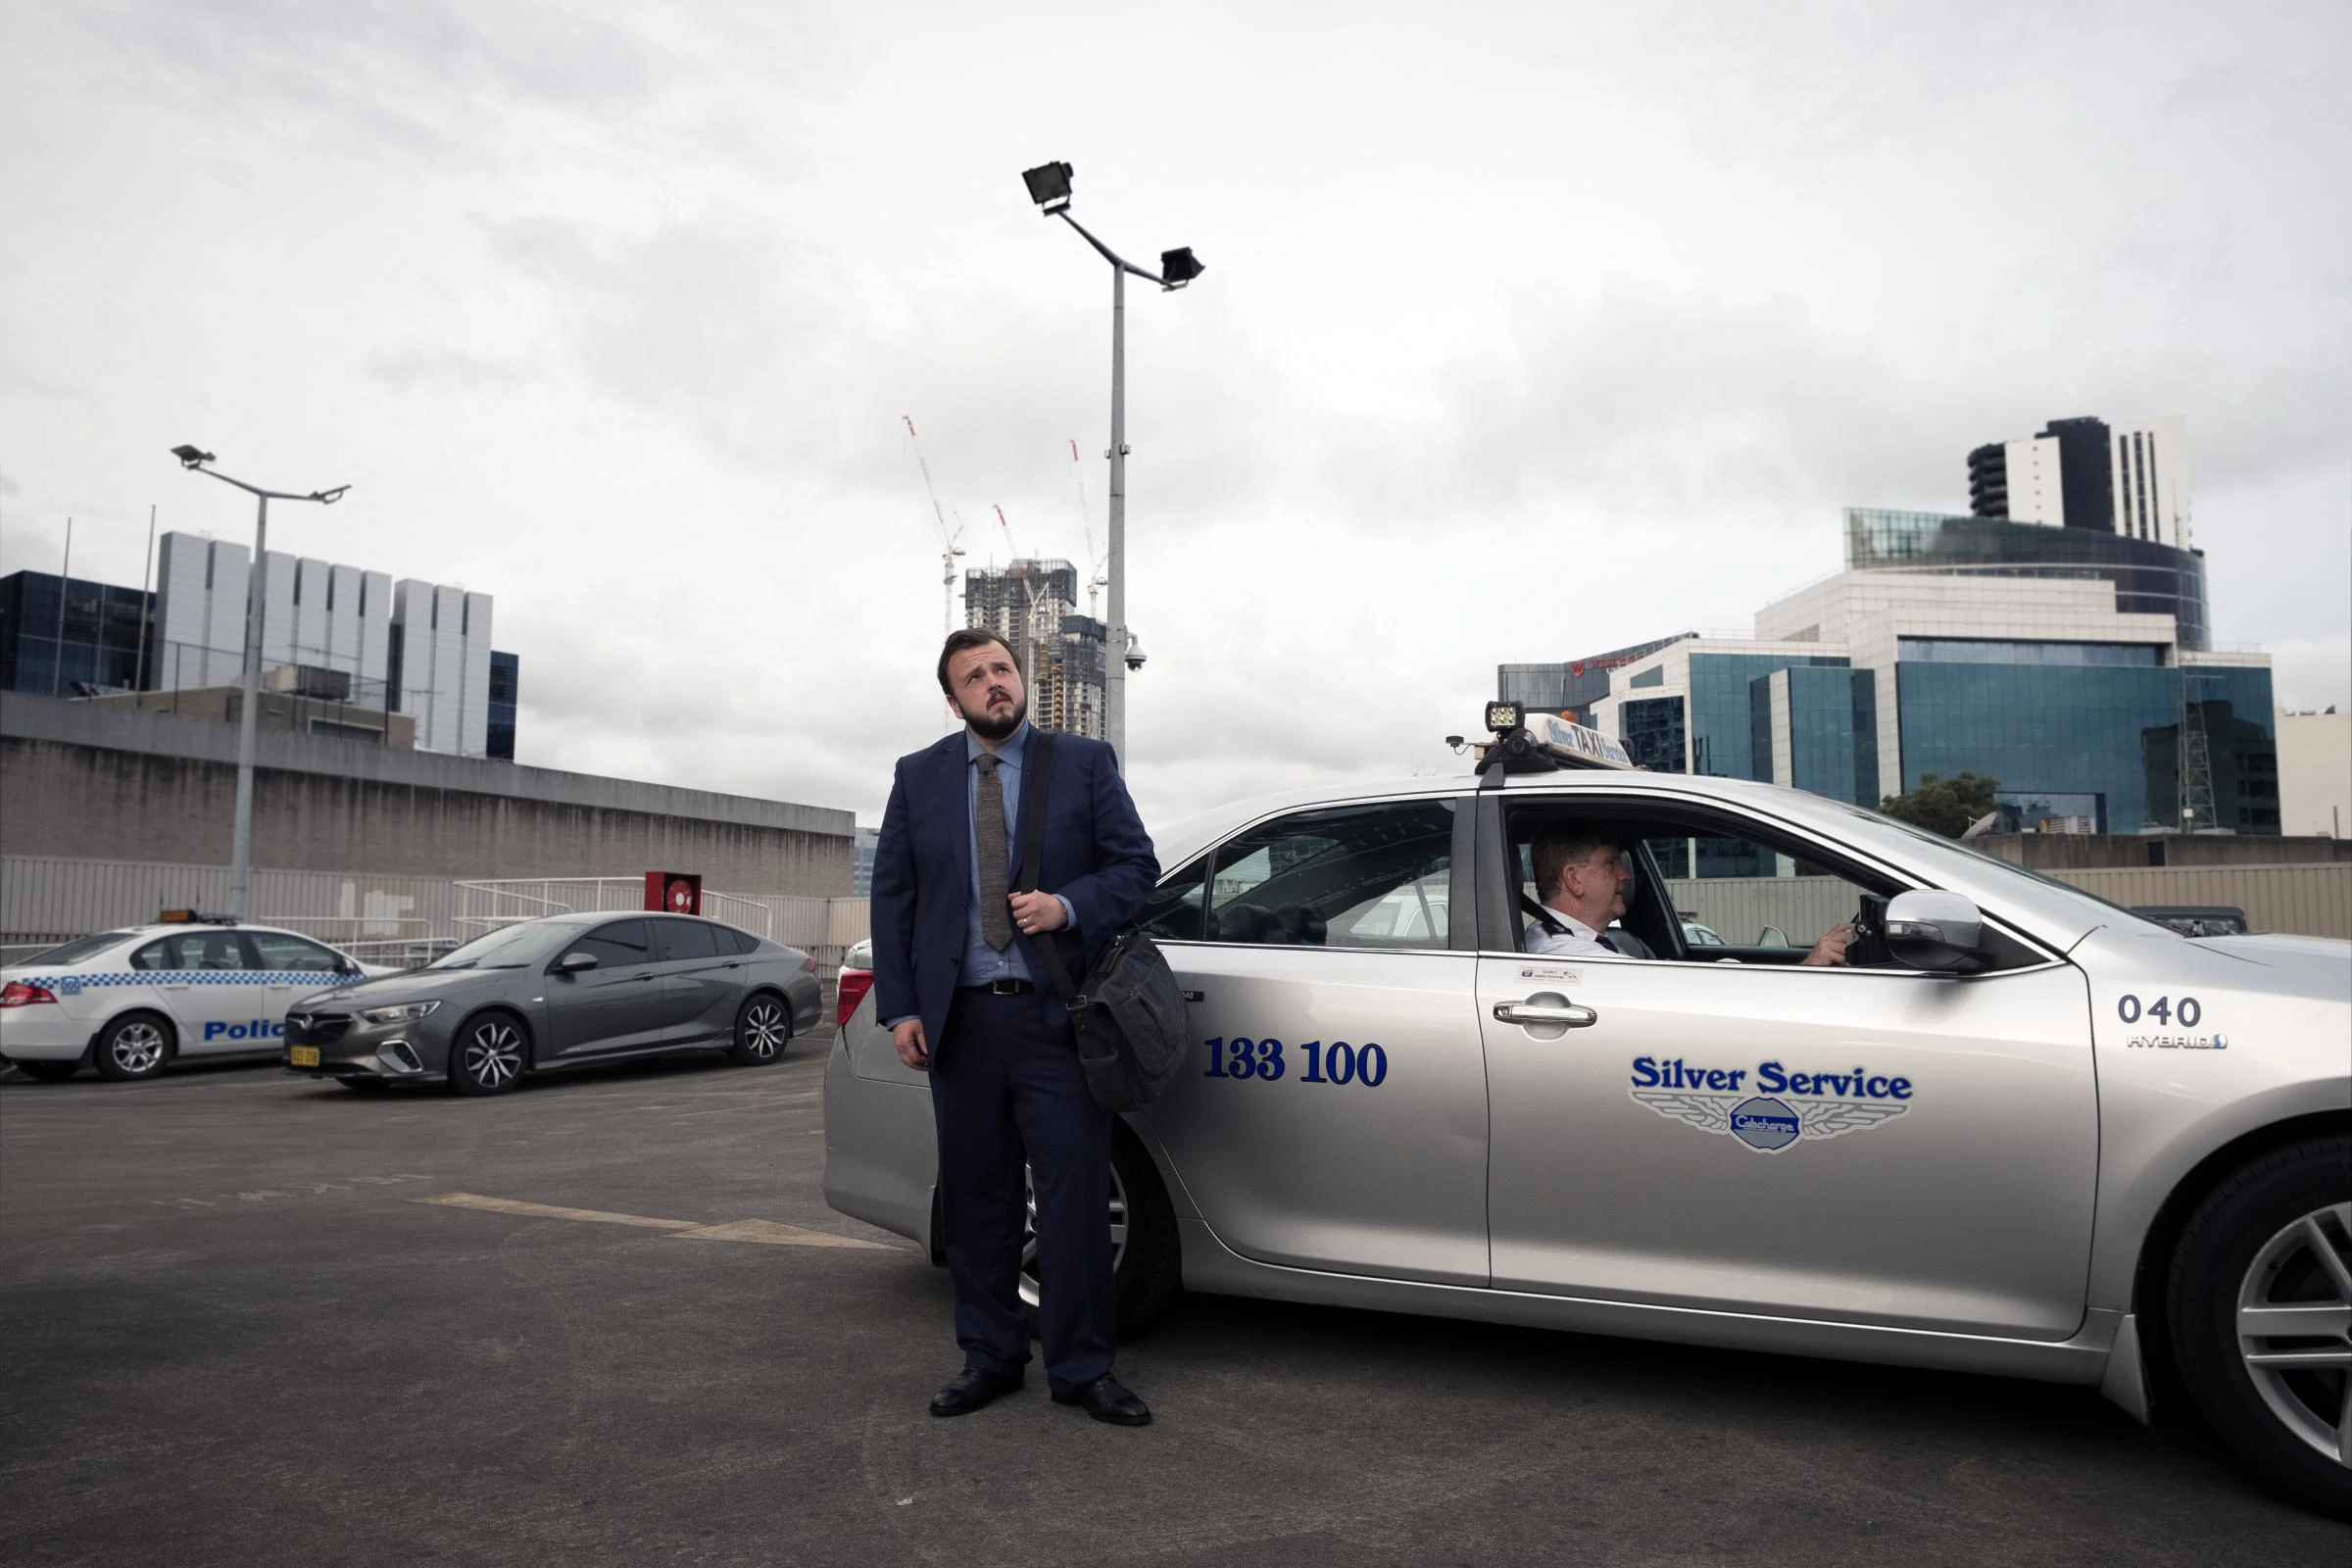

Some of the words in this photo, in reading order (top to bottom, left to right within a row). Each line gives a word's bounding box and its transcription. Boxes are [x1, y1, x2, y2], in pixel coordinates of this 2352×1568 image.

[1571, 725, 1603, 758] TAXI
[2118, 994, 2201, 1028] 040
[204, 1019, 285, 1041] Polic
[2127, 1034, 2211, 1049] HYBRID
[1203, 1036, 1286, 1081] 133
[1300, 1040, 1388, 1088] 100
[1631, 1055, 1746, 1091] Silver
[1756, 1060, 1913, 1100] Service
[1735, 1115, 1794, 1133] Cabcharge
